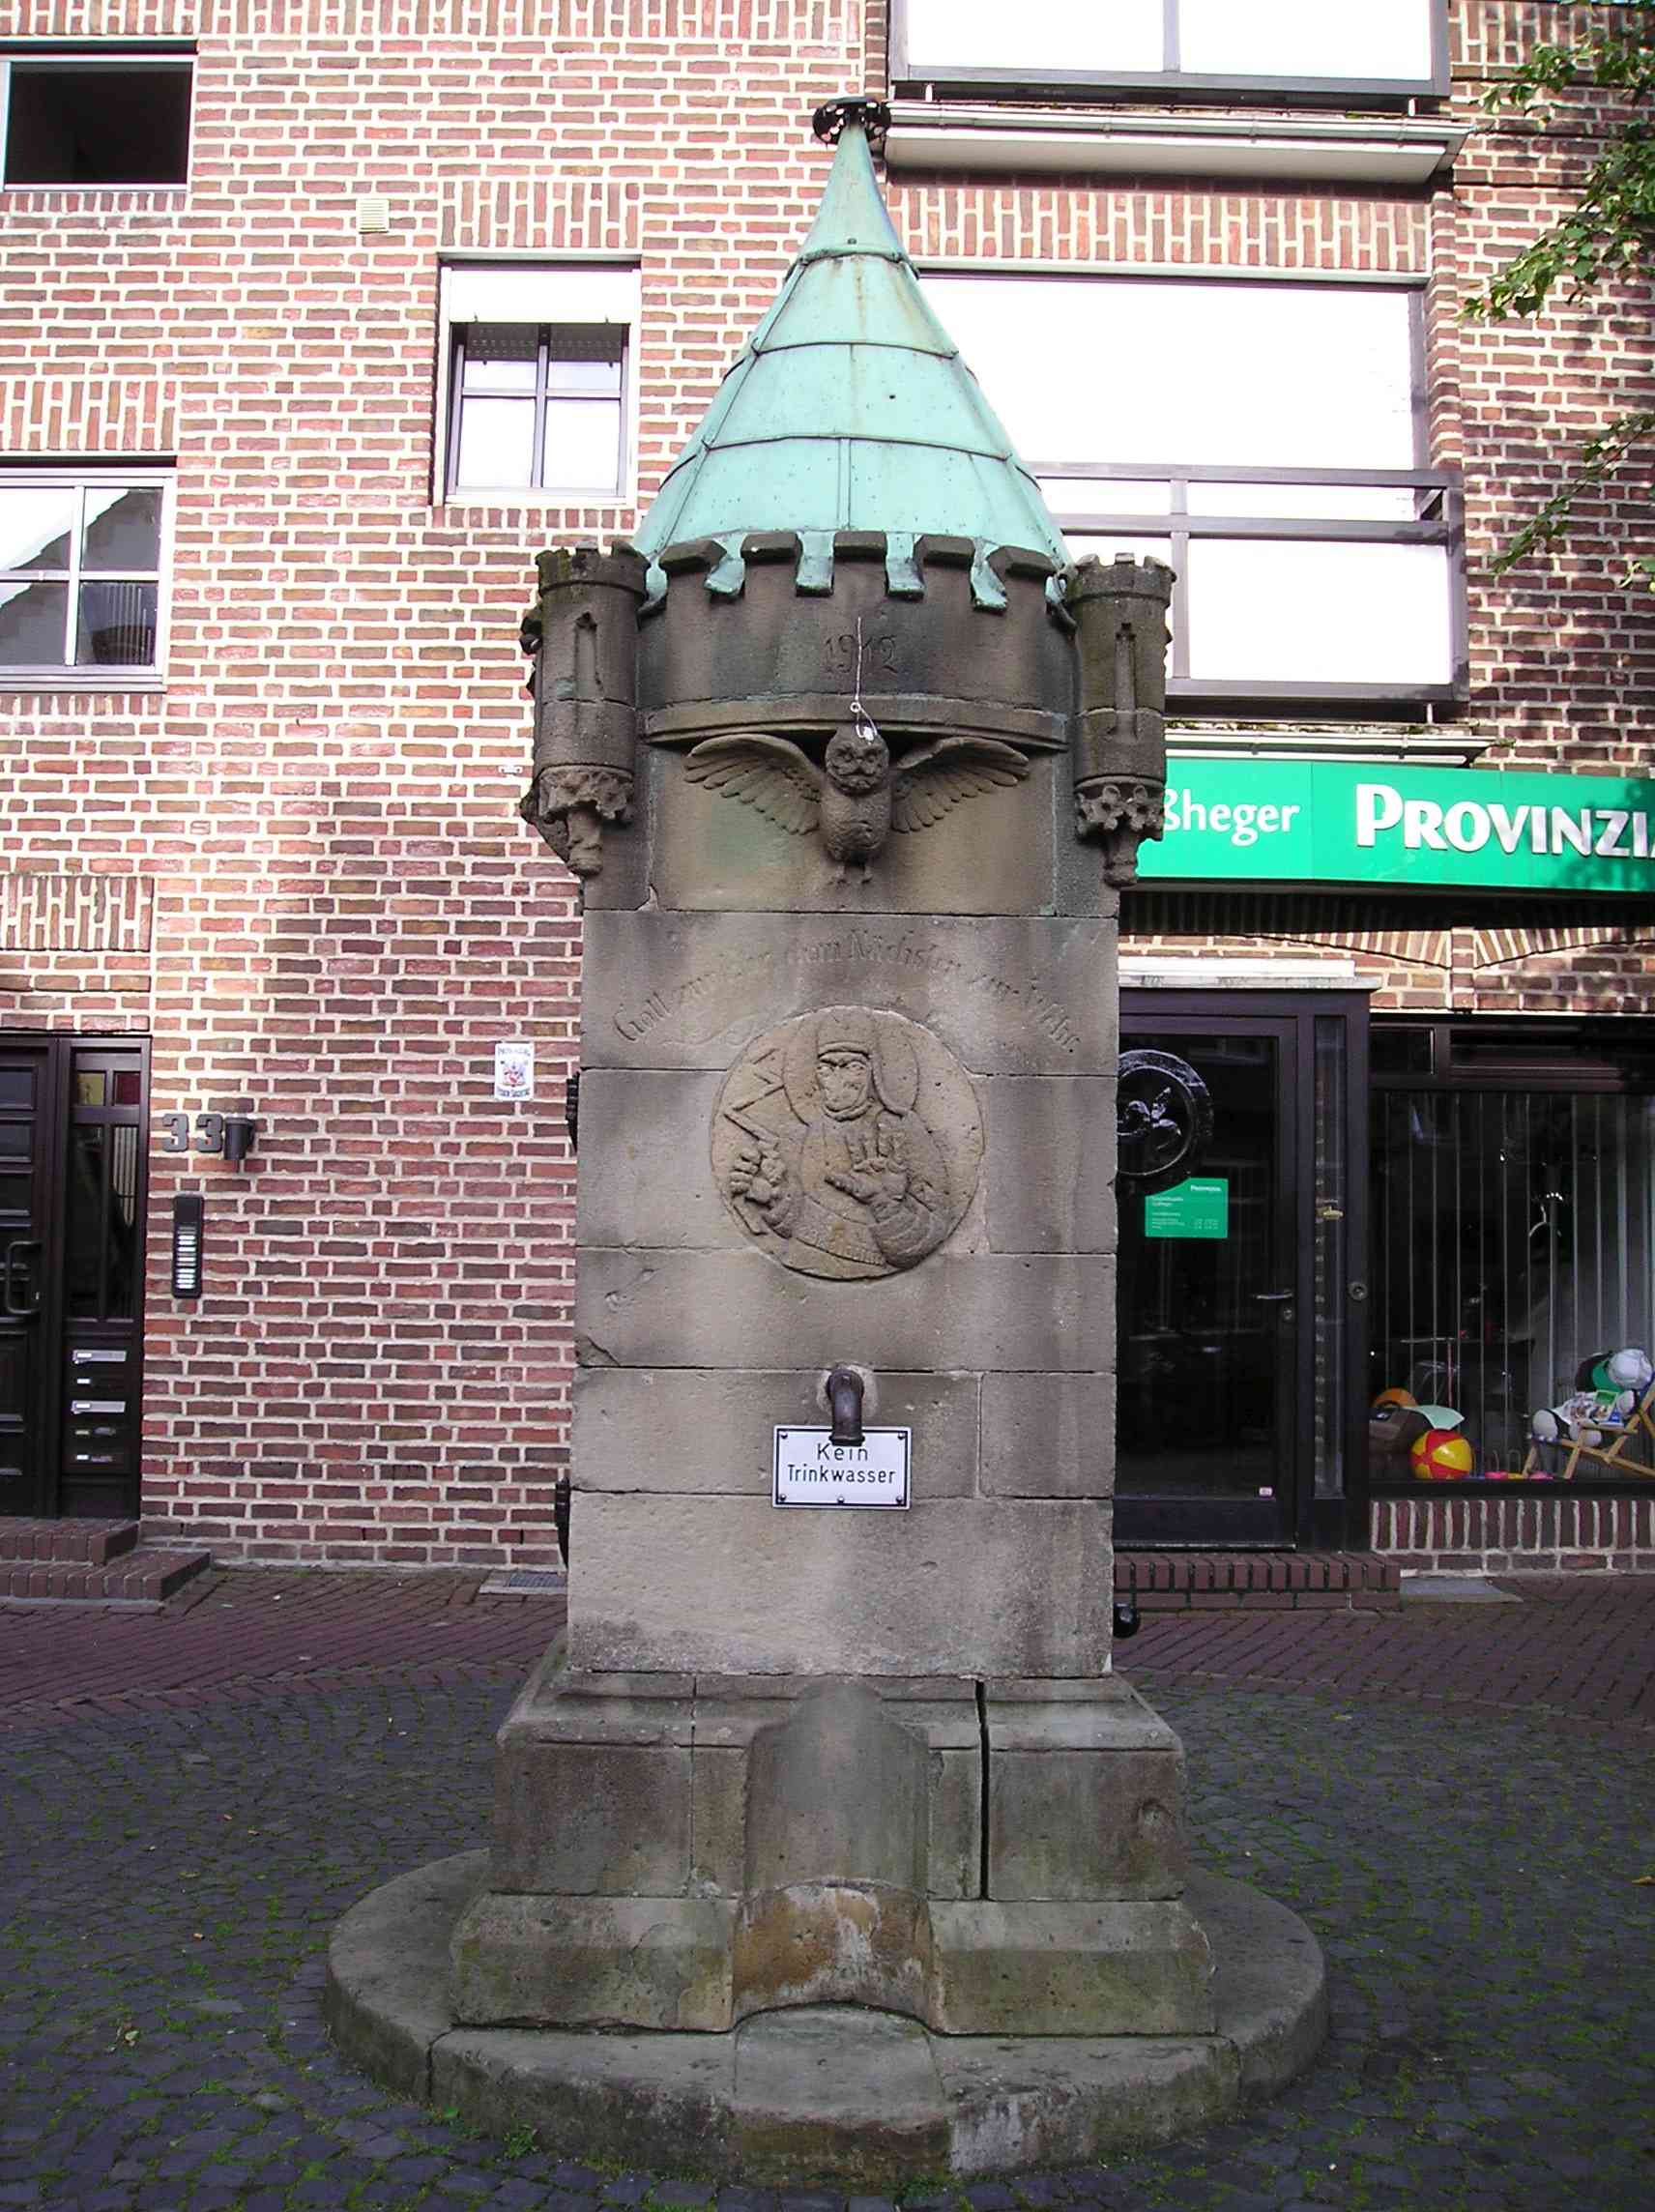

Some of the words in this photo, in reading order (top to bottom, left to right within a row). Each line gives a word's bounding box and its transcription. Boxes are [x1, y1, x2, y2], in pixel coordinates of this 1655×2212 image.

[826, 633, 897, 674] 1912
[1355, 783, 1655, 859] PROVINZI
[162, 1114, 223, 1152] 33
[817, 1442, 868, 1462] Kein
[787, 1464, 896, 1484] Trinkwasser
